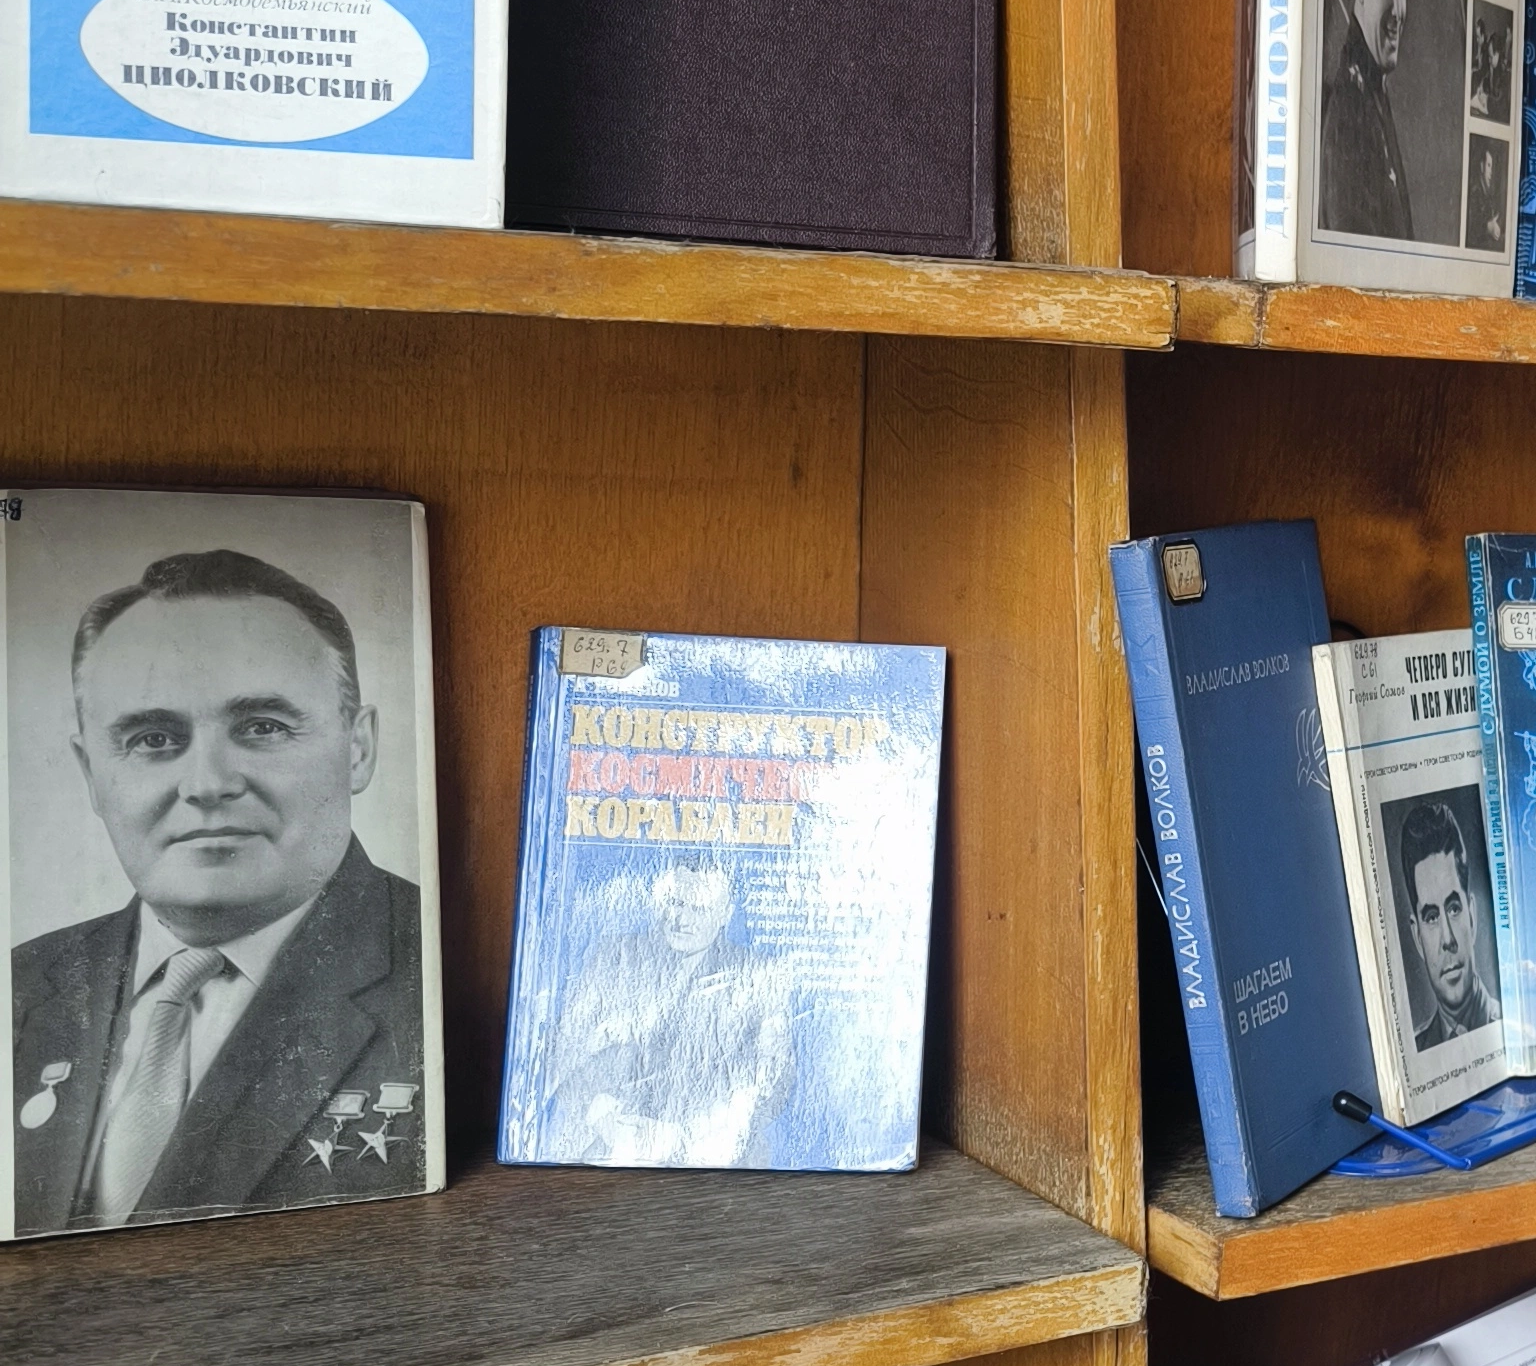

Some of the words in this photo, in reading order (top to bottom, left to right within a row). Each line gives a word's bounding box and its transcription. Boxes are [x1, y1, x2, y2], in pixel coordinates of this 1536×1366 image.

[164, 10, 358, 44] Константин
[169, 36, 354, 68] Эдуардович
[121, 64, 395, 103] ЦИОЛКОВСКИЙ
[1470, 550, 1487, 618] ЗЕМЛЕ
[1507, 577, 1523, 602] С
[1474, 621, 1487, 635] О
[1186, 662, 1251, 695] ВЛАДИСЛАВ
[1252, 653, 1290, 679] ВОЛКОВ
[1405, 652, 1448, 684] ЧЕТВЕРО
[1477, 644, 1495, 718] ДУМОЙ
[1410, 694, 1419, 721] И
[1422, 691, 1441, 720] ВСЯ
[1483, 718, 1495, 735] С
[1147, 743, 1179, 841] ВОЛКОВ
[1164, 852, 1208, 1009] ВЛАДИСЛАВ
[1233, 956, 1292, 1004] ШАГАЕМ
[1237, 1010, 1249, 1036] В
[1251, 991, 1289, 1030] НЕБО
